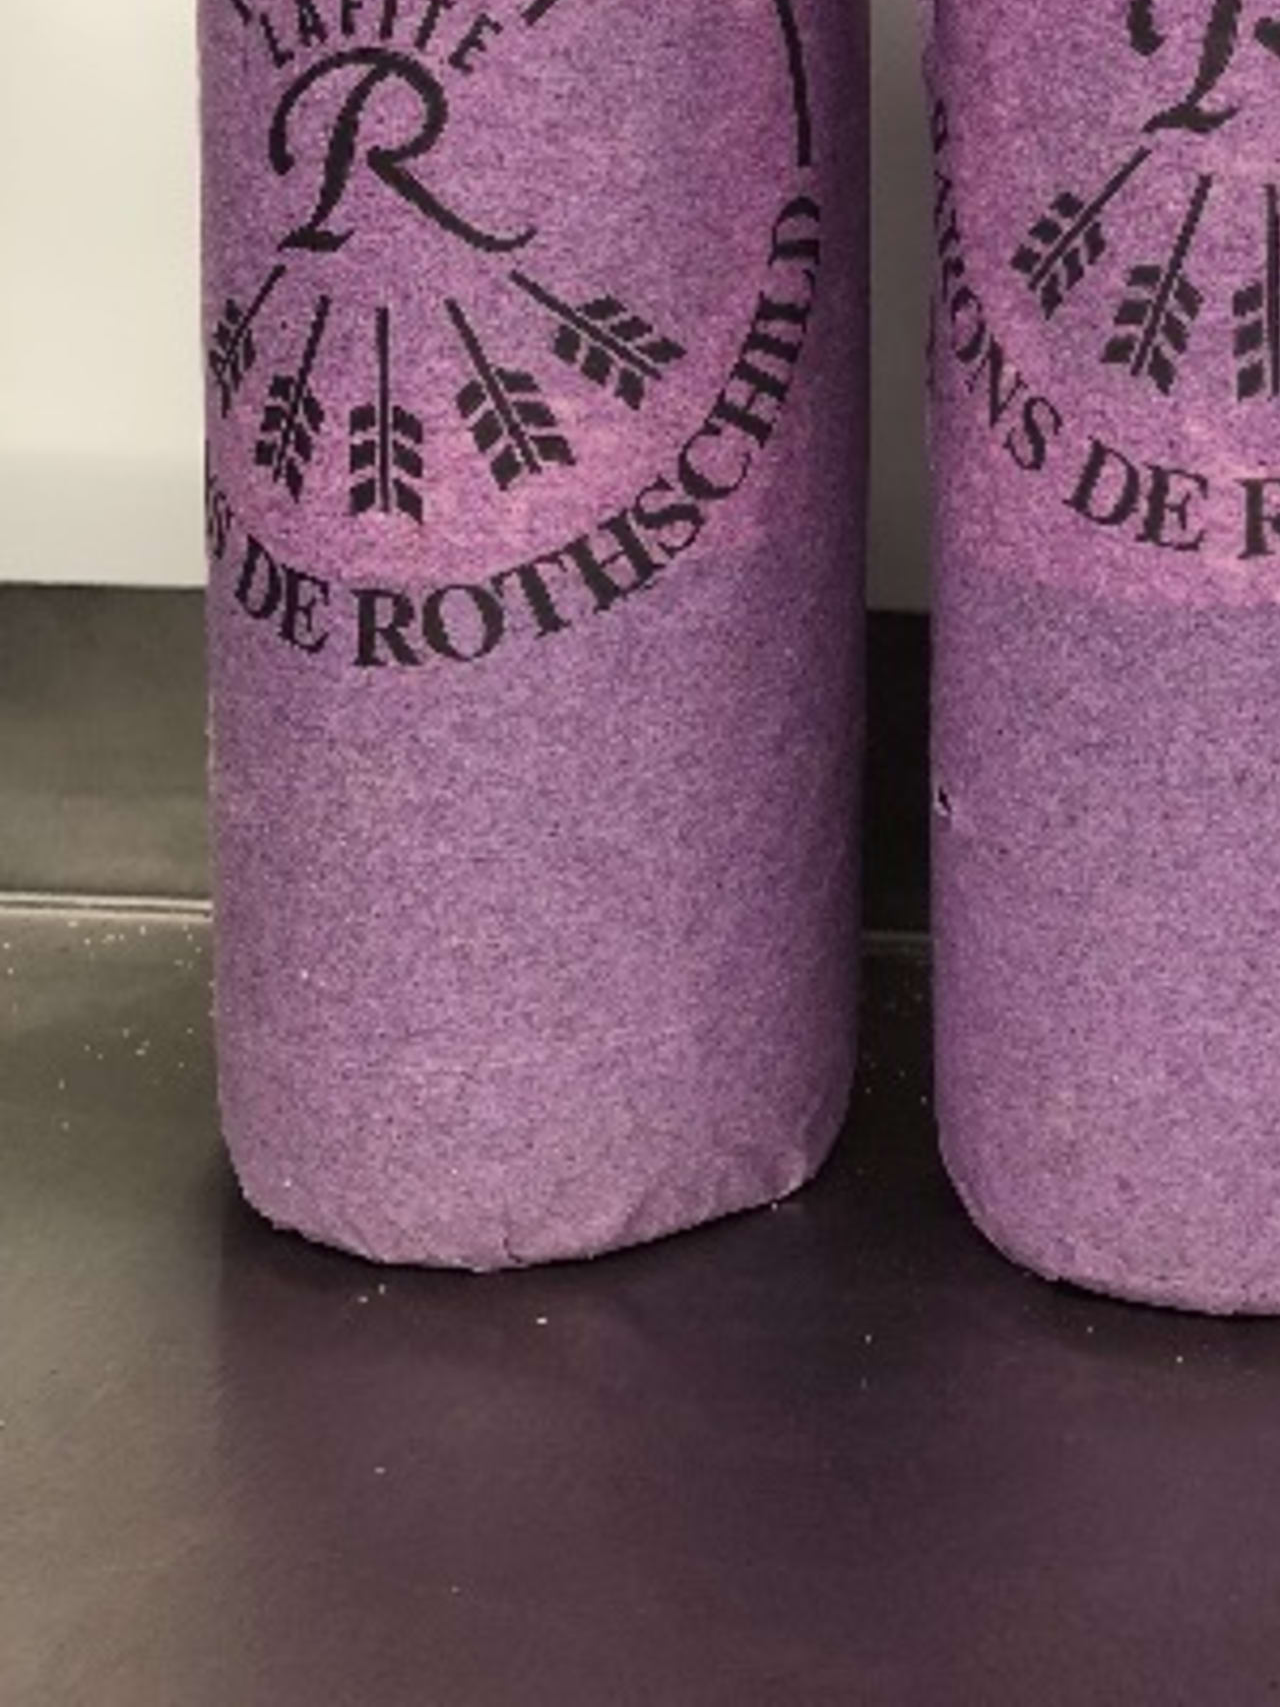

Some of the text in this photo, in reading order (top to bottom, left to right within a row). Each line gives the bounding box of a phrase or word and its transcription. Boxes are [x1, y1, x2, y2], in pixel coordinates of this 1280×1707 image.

[269, 48, 537, 253] R
[234, 532, 330, 654] DE
[352, 196, 821, 667] ROTHSCHILD
[1063, 437, 1209, 552] DE
